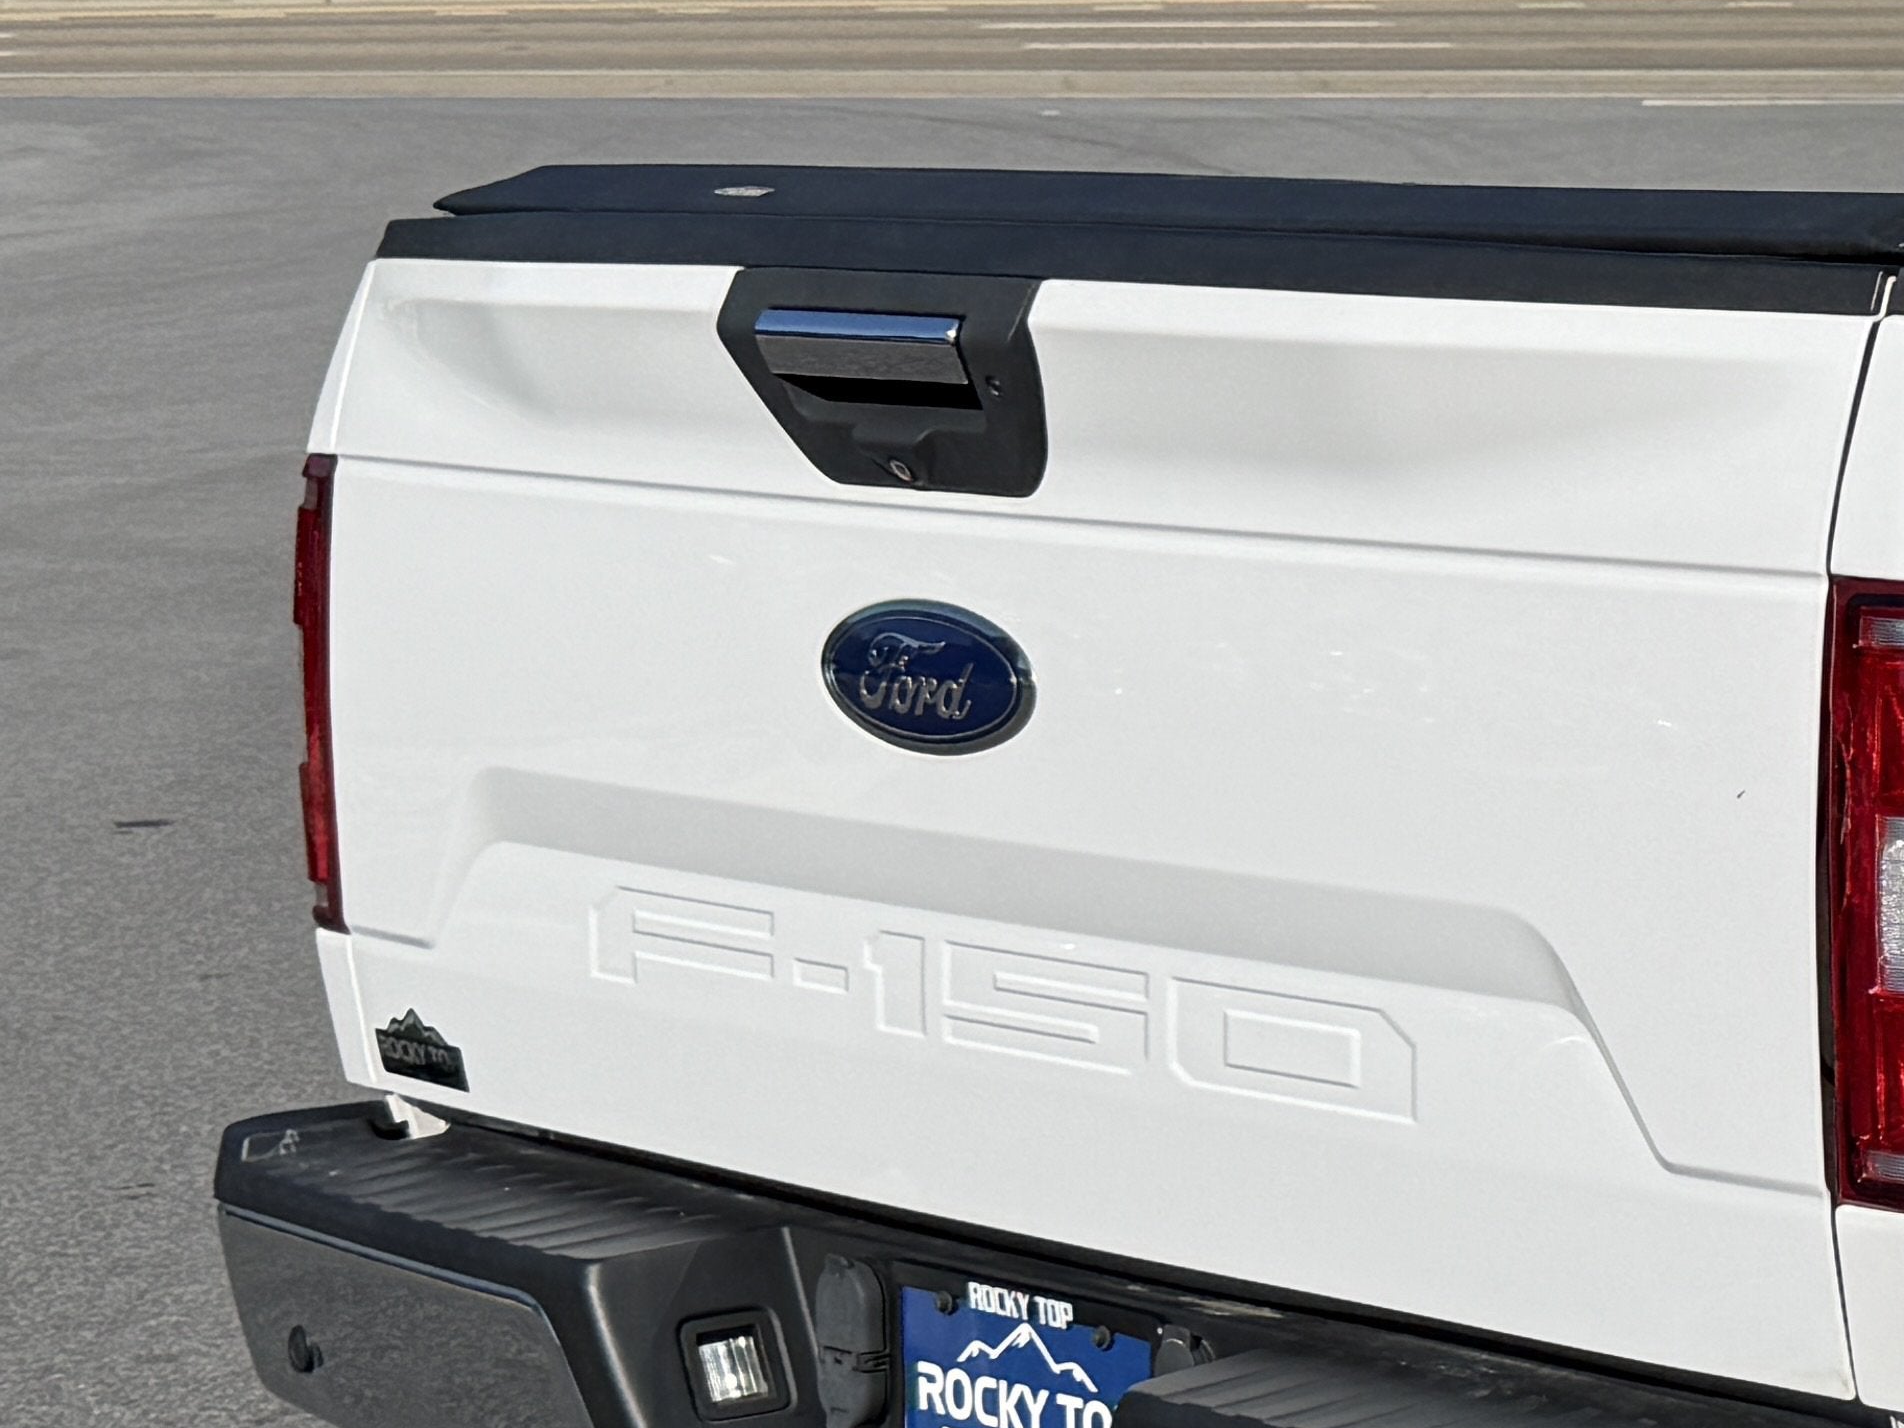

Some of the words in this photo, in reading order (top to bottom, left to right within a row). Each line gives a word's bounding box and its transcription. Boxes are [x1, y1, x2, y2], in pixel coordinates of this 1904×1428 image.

[860, 631, 974, 720] Ford
[590, 885, 1418, 1124] F-150
[967, 1281, 1031, 1321] ROCKY
[1035, 1295, 1073, 1329] TOP
